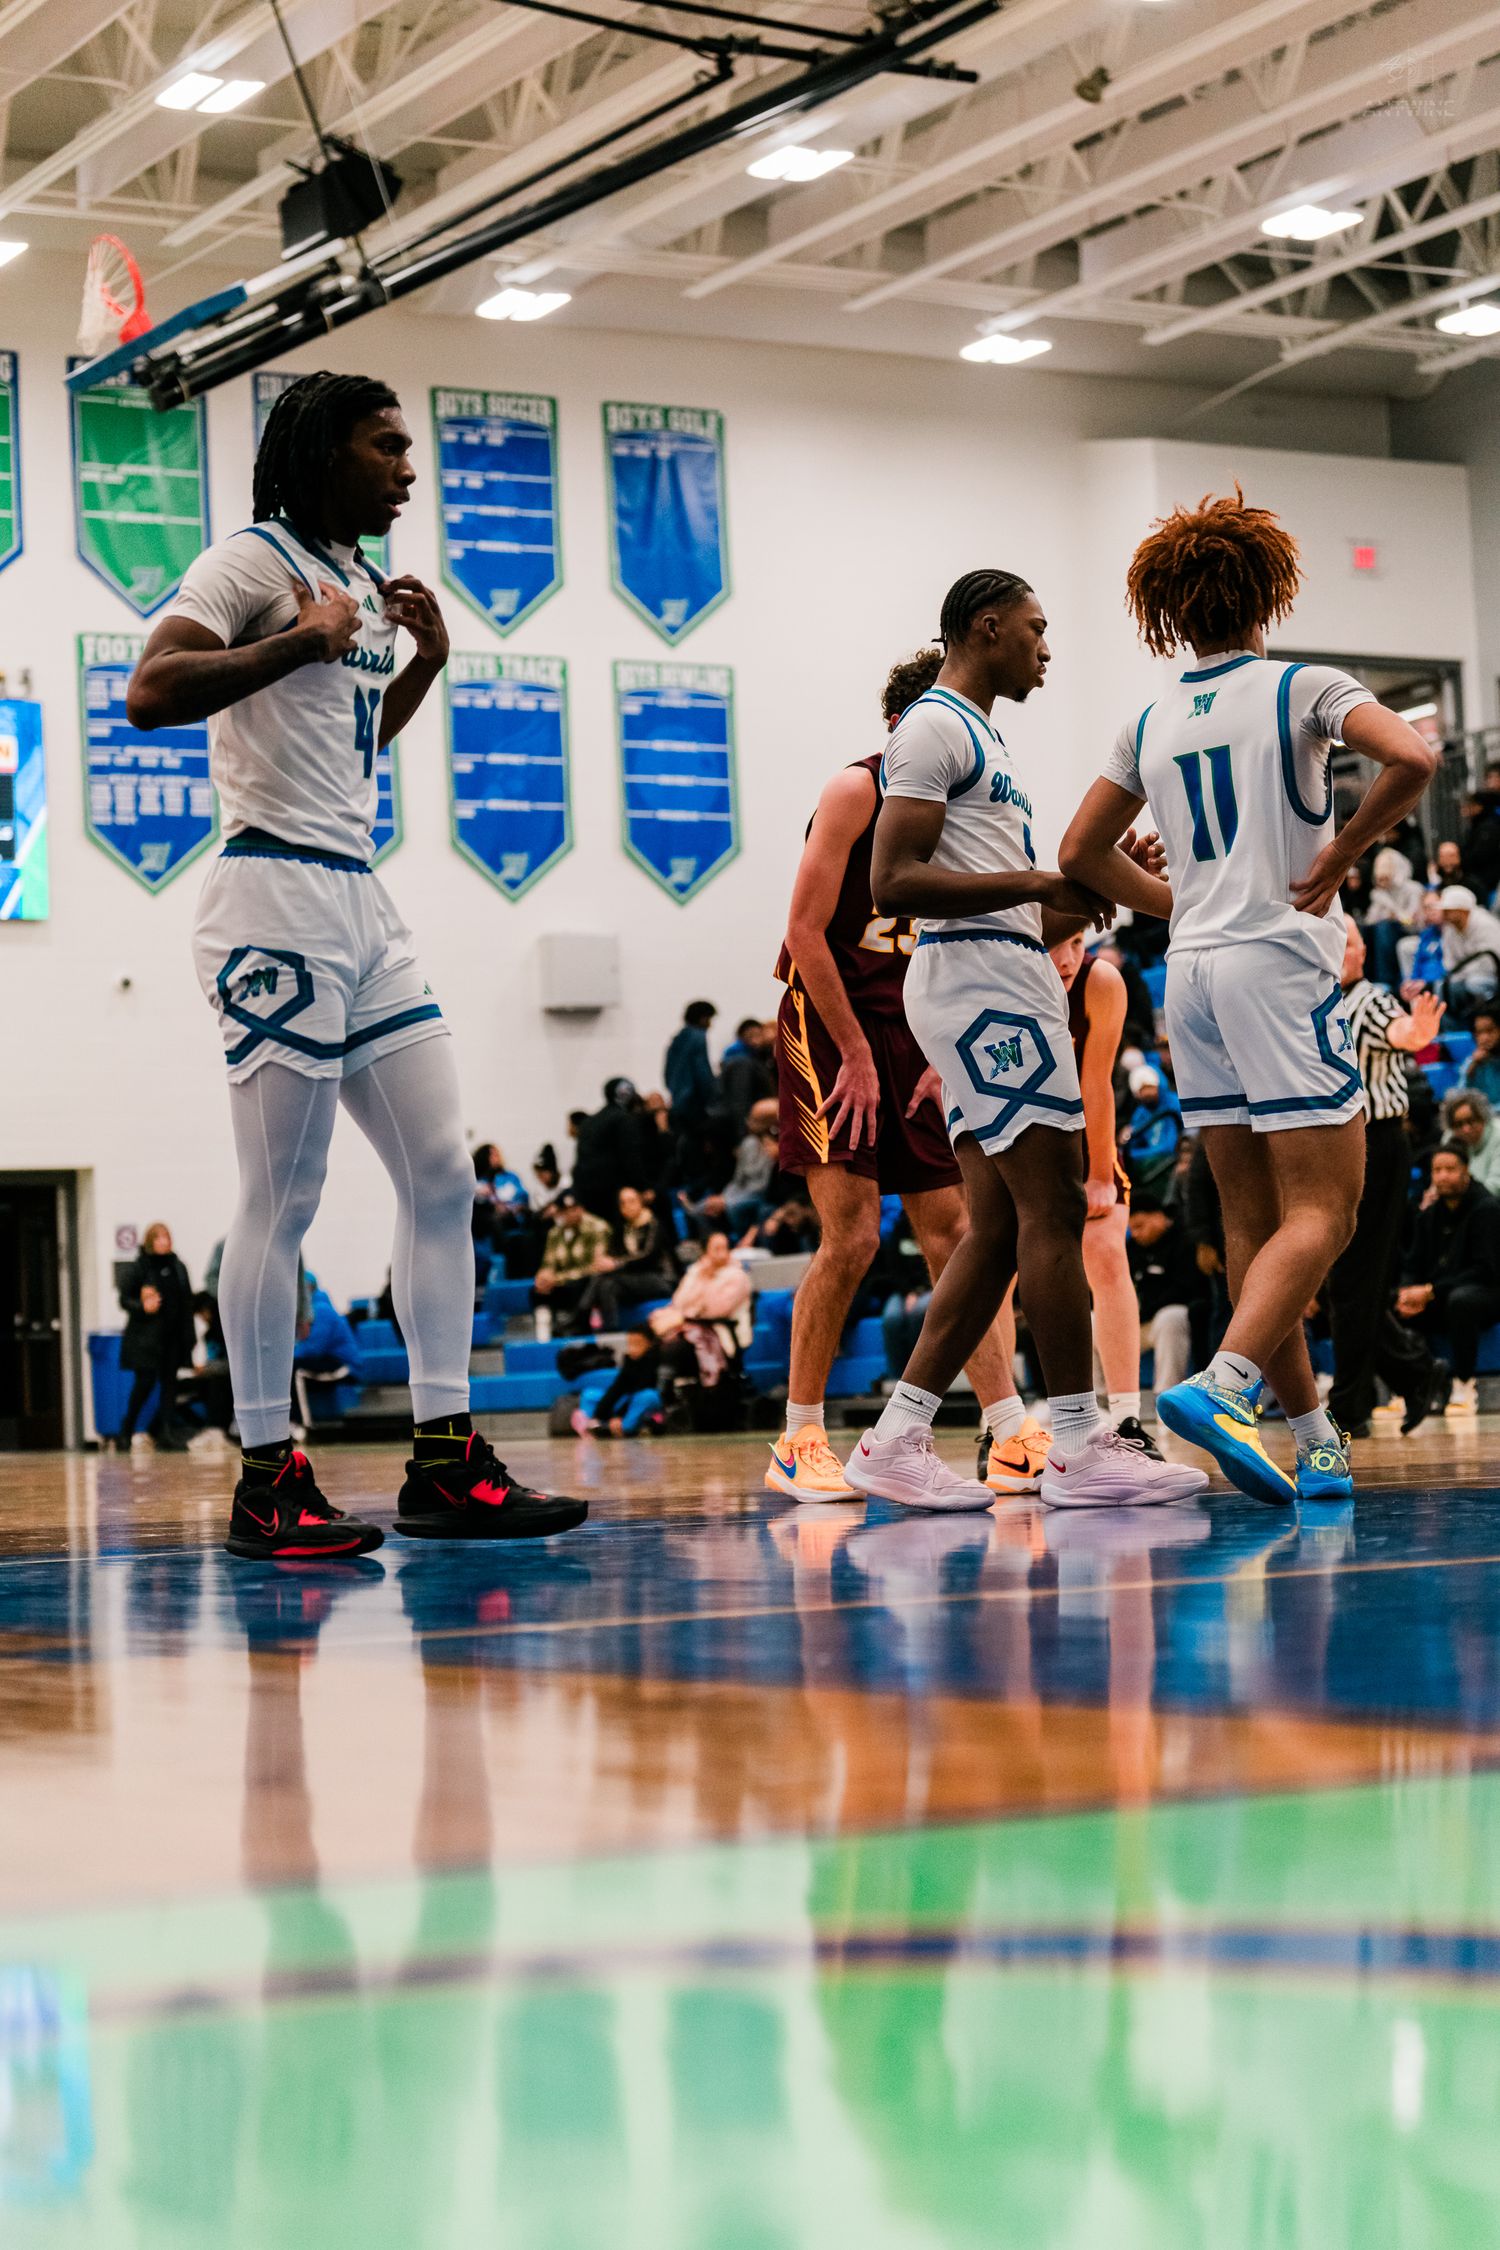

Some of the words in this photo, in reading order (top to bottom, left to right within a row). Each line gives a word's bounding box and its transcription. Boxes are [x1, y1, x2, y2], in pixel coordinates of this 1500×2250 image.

[436, 391, 482, 417] BOYS
[487, 394, 551, 426] SOCCER
[607, 405, 662, 432] BOYS
[83, 637, 149, 665] FOOT
[341, 645, 394, 675] arri
[353, 684, 381, 779] 4
[989, 770, 1033, 819] Warri
[1172, 744, 1239, 863] 11
